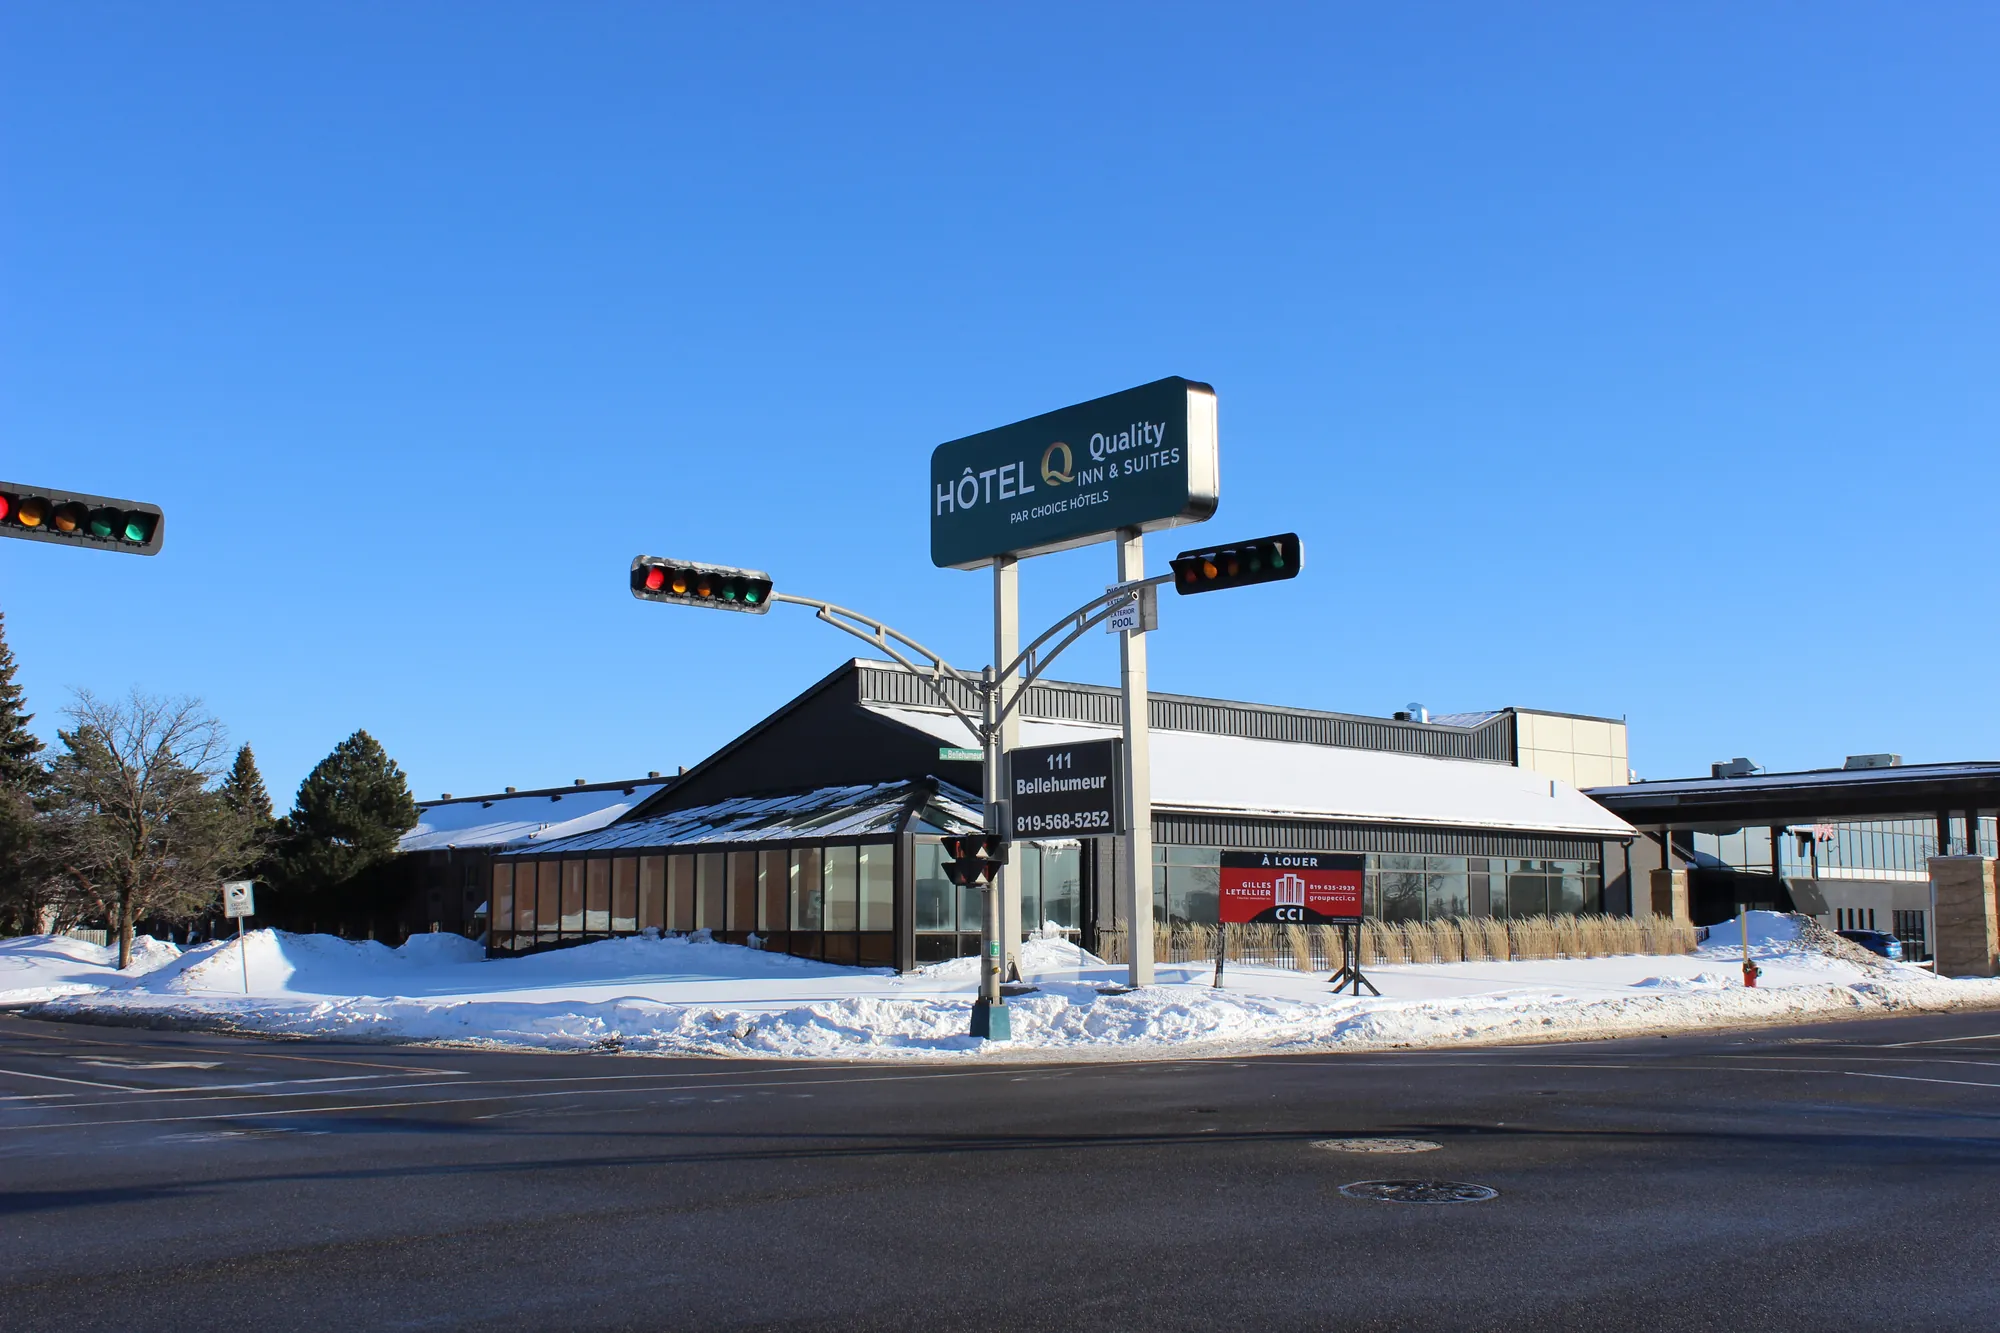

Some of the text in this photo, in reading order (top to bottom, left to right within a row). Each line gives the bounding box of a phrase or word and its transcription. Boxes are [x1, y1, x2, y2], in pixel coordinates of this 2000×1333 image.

[1089, 421, 1166, 461] Quality
[1041, 441, 1075, 486] Q
[1077, 448, 1180, 486] INN & SUITES
[936, 461, 1035, 516] HÔTEL
[1010, 490, 1109, 524] PAR CHOICE HÔTELS
[1112, 617, 1133, 628] POOL
[1047, 752, 1072, 770] 111
[1016, 775, 1107, 795] Bellehumeur
[1017, 811, 1110, 832] 819-568-5252
[1261, 854, 1318, 867] À LOUER
[1225, 888, 1271, 896] LETELLIER
[1242, 881, 1271, 889] GILLES
[1275, 908, 1304, 921] CCI
